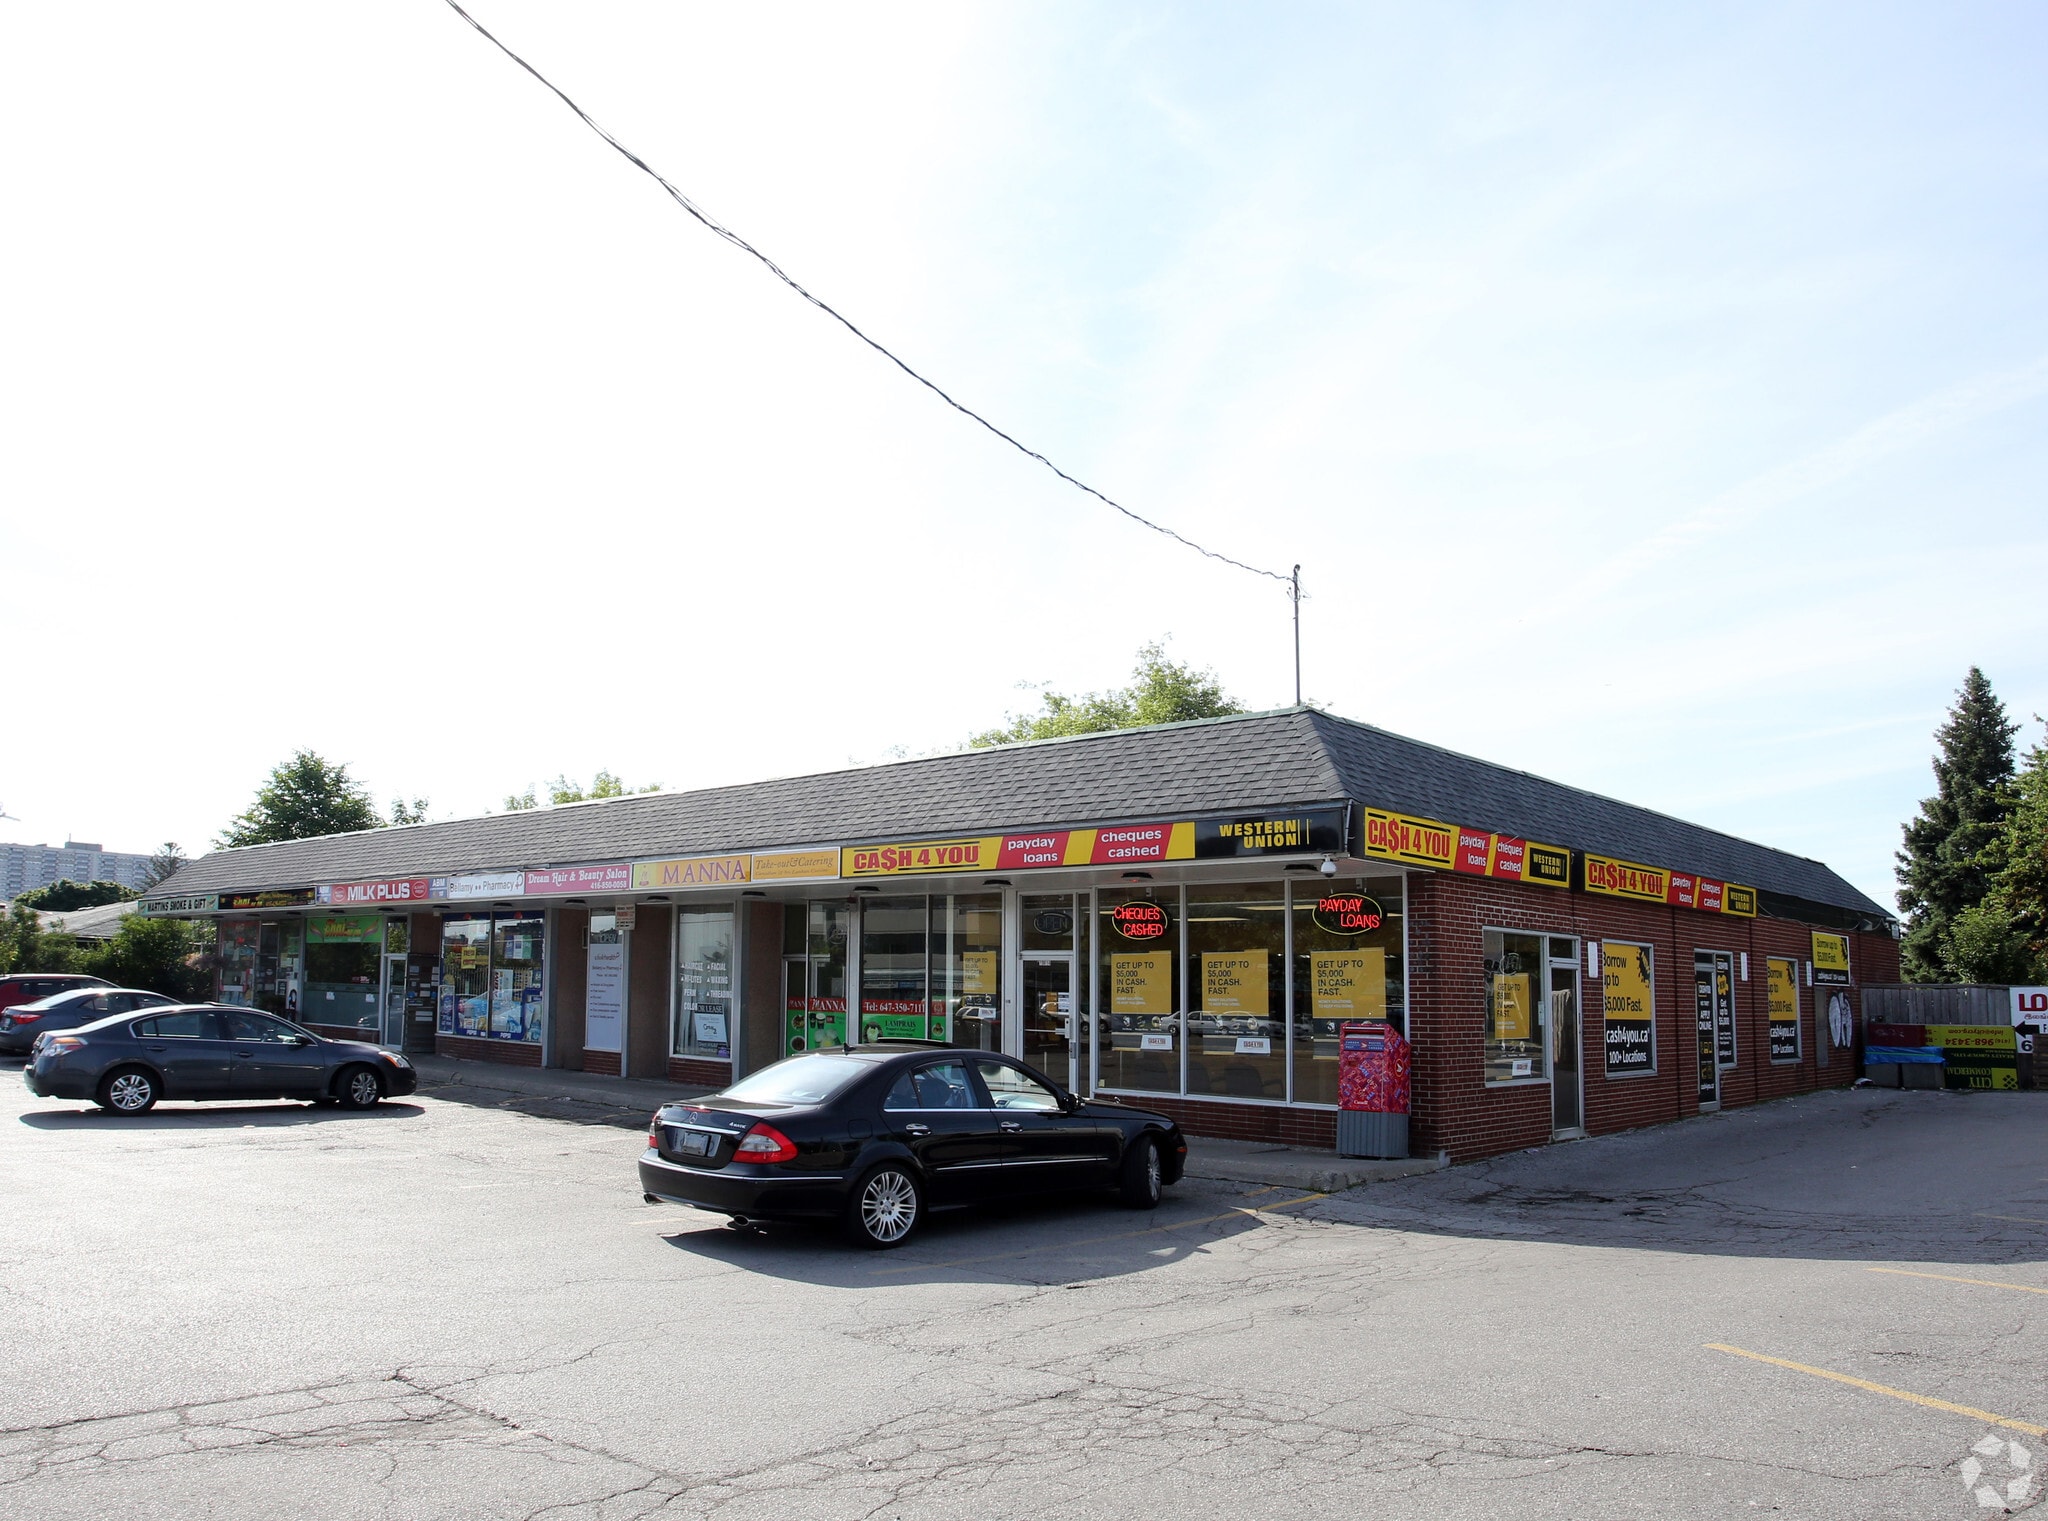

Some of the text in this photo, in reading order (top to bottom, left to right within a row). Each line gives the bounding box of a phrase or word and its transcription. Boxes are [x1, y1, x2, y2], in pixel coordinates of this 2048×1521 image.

[1219, 820, 1297, 837] WESTERN
[1007, 836, 1056, 850] payday
[1101, 829, 1162, 843] cheques
[1243, 833, 1297, 849] UNION
[1460, 835, 1486, 850] payday
[1412, 829, 1422, 852] 4
[1424, 830, 1450, 858] YOU
[1498, 842, 1522, 856] cheques
[917, 850, 930, 866] 4
[936, 846, 979, 866] YOU
[1023, 852, 1058, 864] loans
[1108, 845, 1160, 858] cashed
[1468, 852, 1486, 867] loans
[1500, 860, 1522, 873] cashed
[1532, 853, 1560, 866] WESTERN
[528, 866, 627, 887] Dream Hair & Beauty Salon
[662, 860, 746, 884] MANNA
[1541, 864, 1560, 876] UNION
[432, 878, 446, 887] ABM
[482, 879, 514, 892] Pharmacy
[1630, 872, 1637, 890] 4
[1640, 873, 1662, 894] YOU
[348, 886, 376, 901] MILK
[377, 882, 410, 900] PLUS
[170, 900, 187, 911] SMOKE
[194, 898, 206, 909] GIFT
[1319, 899, 1363, 912] PAYDAY
[1114, 906, 1160, 920] CHEQUES
[1340, 913, 1380, 928] LOANS
[1123, 923, 1163, 936] CASHED
[711, 963, 726, 971] FACIAL
[1317, 970, 1343, 978] $5,000
[1612, 972, 1619, 986] to
[706, 1005, 723, 1014] LEASE
[865, 1002, 878, 1010] Tel:
[1627, 997, 1642, 1012] Fast.
[1606, 1026, 1648, 1047] cash4you.ca
[1609, 1049, 1646, 1063] 100+ Locations
[1968, 1077, 1992, 1088] CITY
